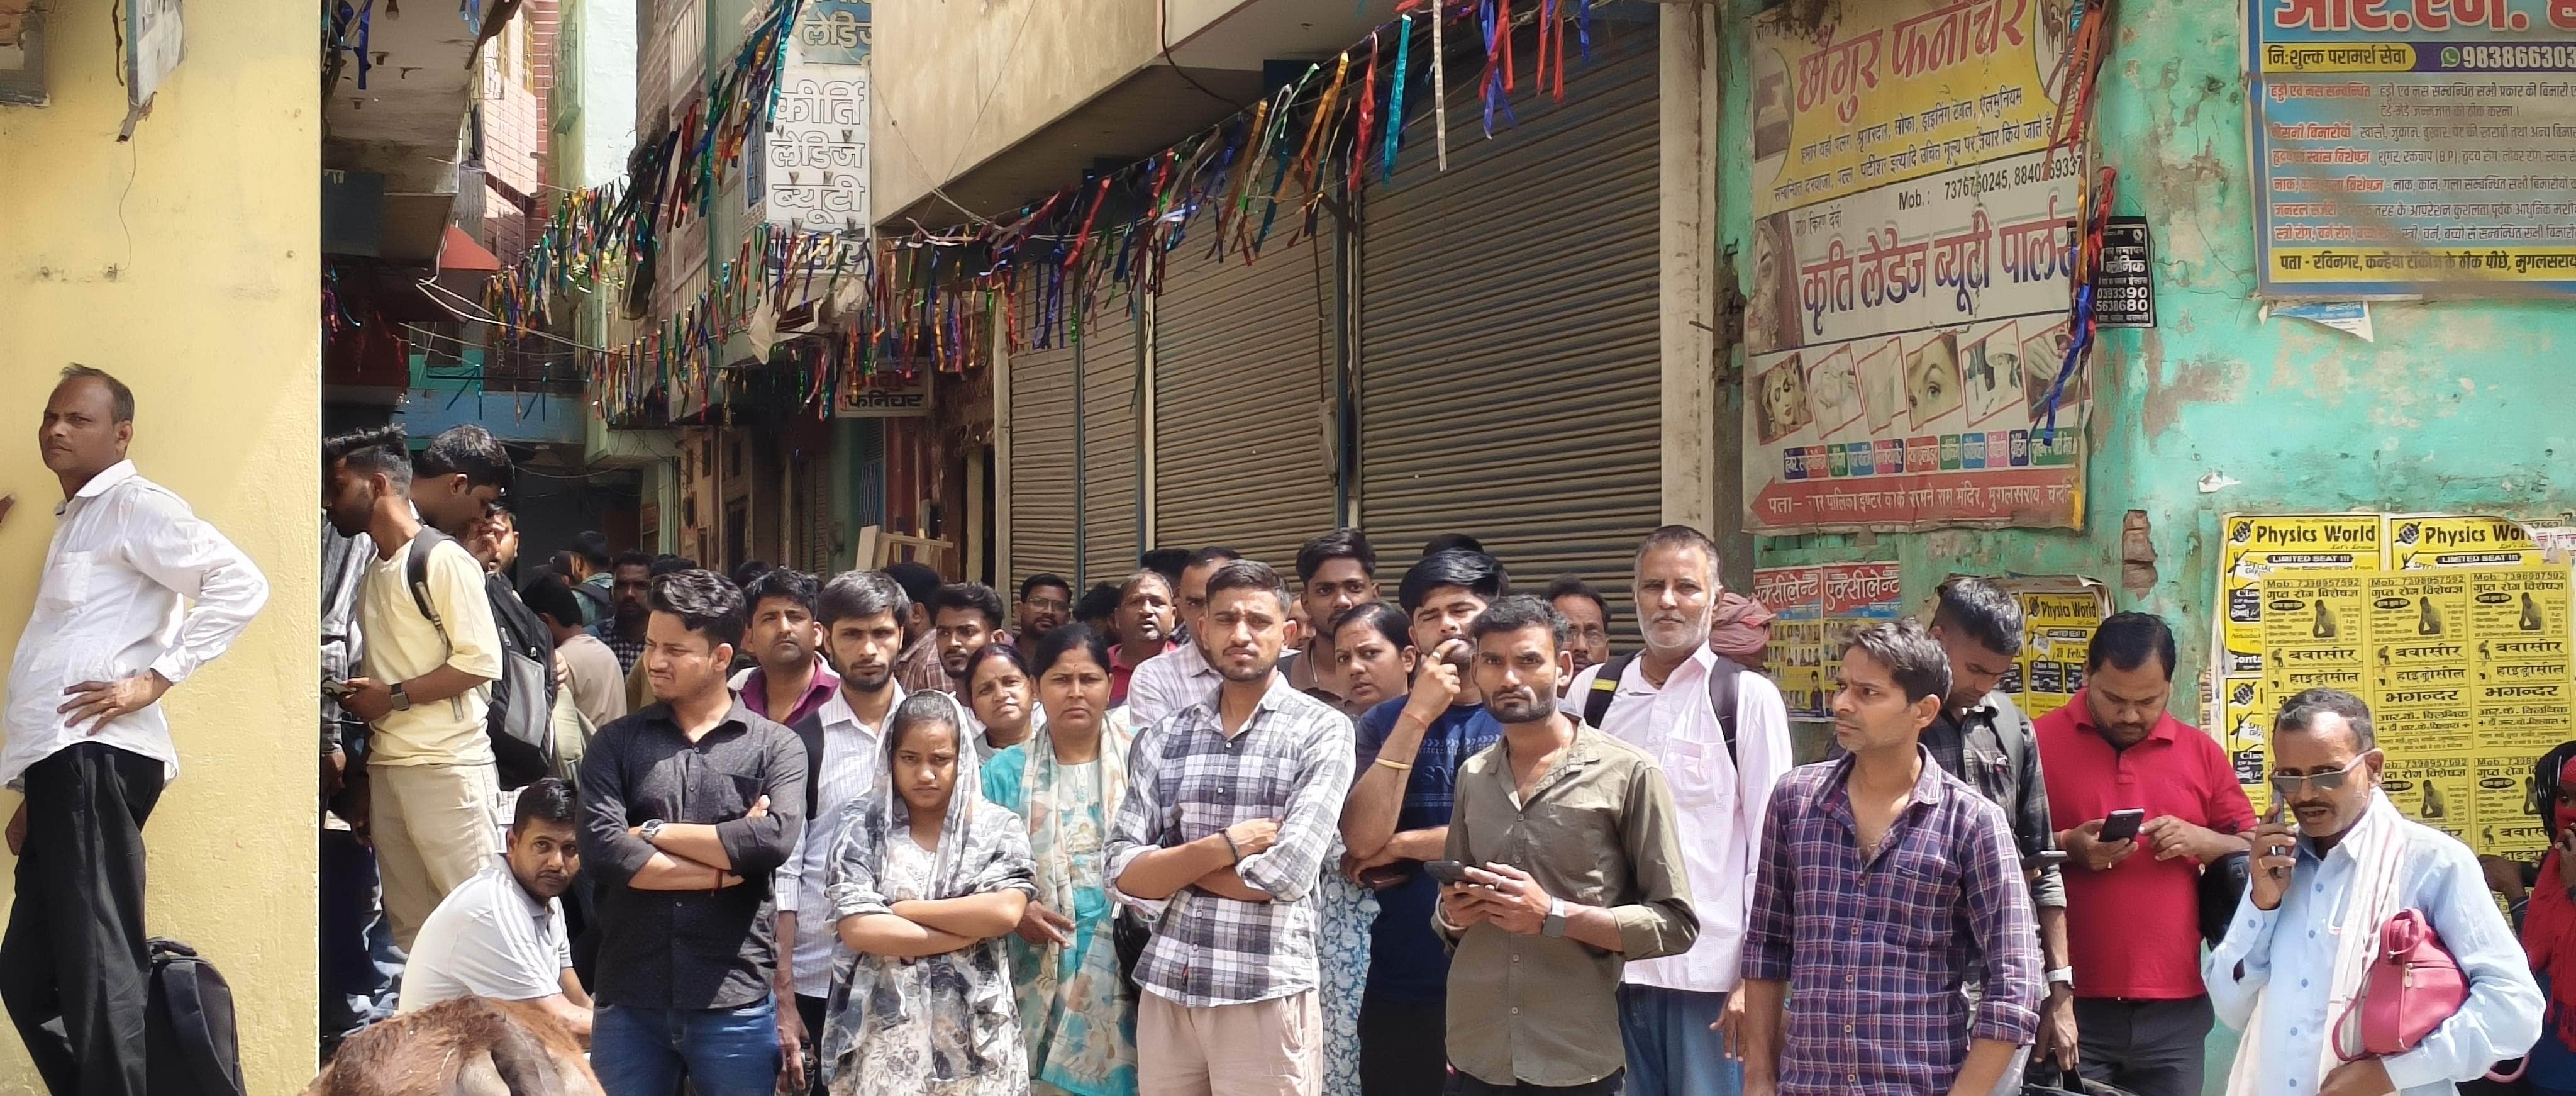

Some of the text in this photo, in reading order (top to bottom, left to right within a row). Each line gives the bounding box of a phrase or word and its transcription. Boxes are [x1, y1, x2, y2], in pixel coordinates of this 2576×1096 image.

[2327, 45, 2377, 64] परामर्श
[2379, 44, 2407, 64] सेवा
[2499, 85, 2523, 97] प्रकार
[776, 79, 865, 125] कीर्ति
[770, 131, 865, 169] लेडिज
[772, 174, 866, 224] ब्यूटी
[2280, 254, 2302, 269] पता
[2313, 250, 2363, 271] रविनगर,
[2458, 250, 2482, 269] ठीक
[2485, 250, 2511, 271] पीछे,
[1768, 494, 1792, 515] पता
[1936, 488, 1953, 506] राम
[2257, 525, 2375, 546] Physics World
[2425, 526, 2487, 547] Physics
[2493, 524, 2532, 542] Wor
[2313, 554, 2336, 563] SEAT
[2294, 588, 2314, 598] रोग
[2500, 582, 2521, 591] रोग
[2289, 646, 2358, 661] बवासीर
[2395, 642, 2465, 657] बवासीर
[2495, 639, 2564, 653] बवासीर
[2385, 690, 2460, 703] भगन्दर
[2485, 685, 2560, 697] भगन्दर
[2384, 759, 2402, 769] ob:
